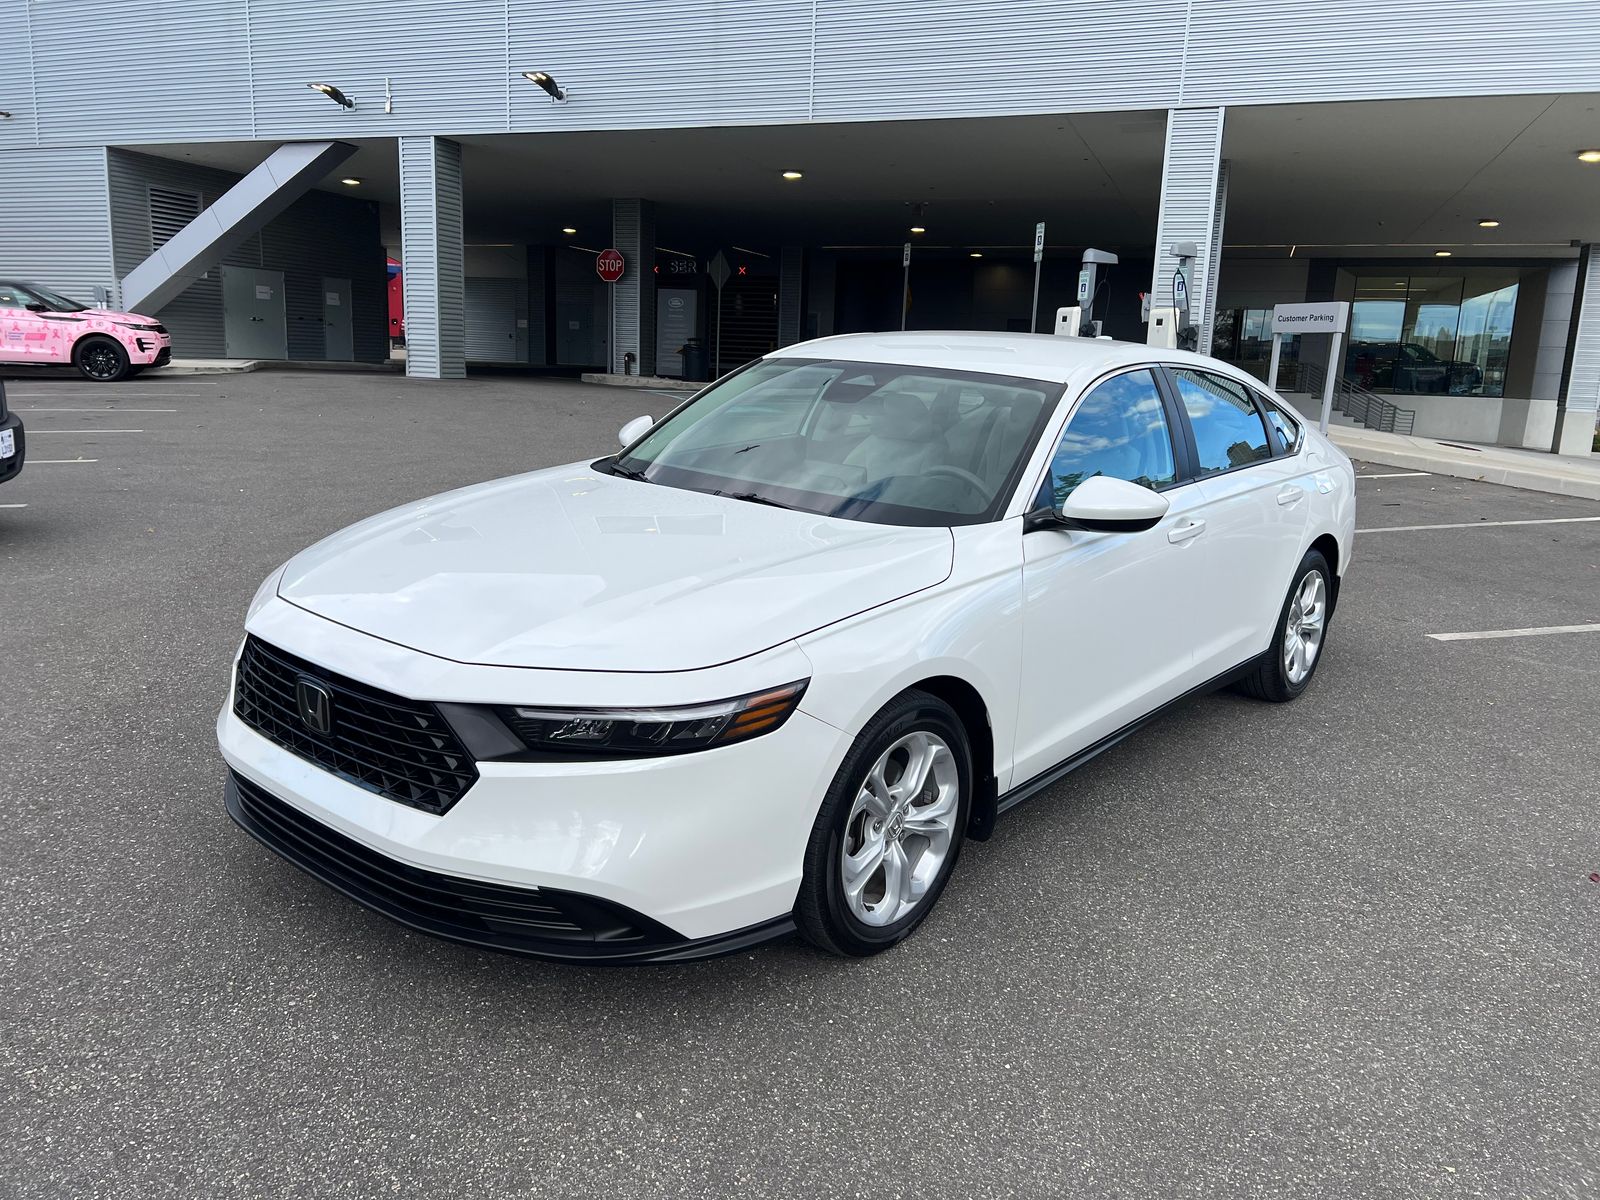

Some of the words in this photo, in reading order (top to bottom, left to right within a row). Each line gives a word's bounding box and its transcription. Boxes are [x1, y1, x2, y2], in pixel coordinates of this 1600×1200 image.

[598, 259, 622, 272] STOP
[1277, 315, 1307, 323] Customer
[1309, 314, 1335, 323] Parking
